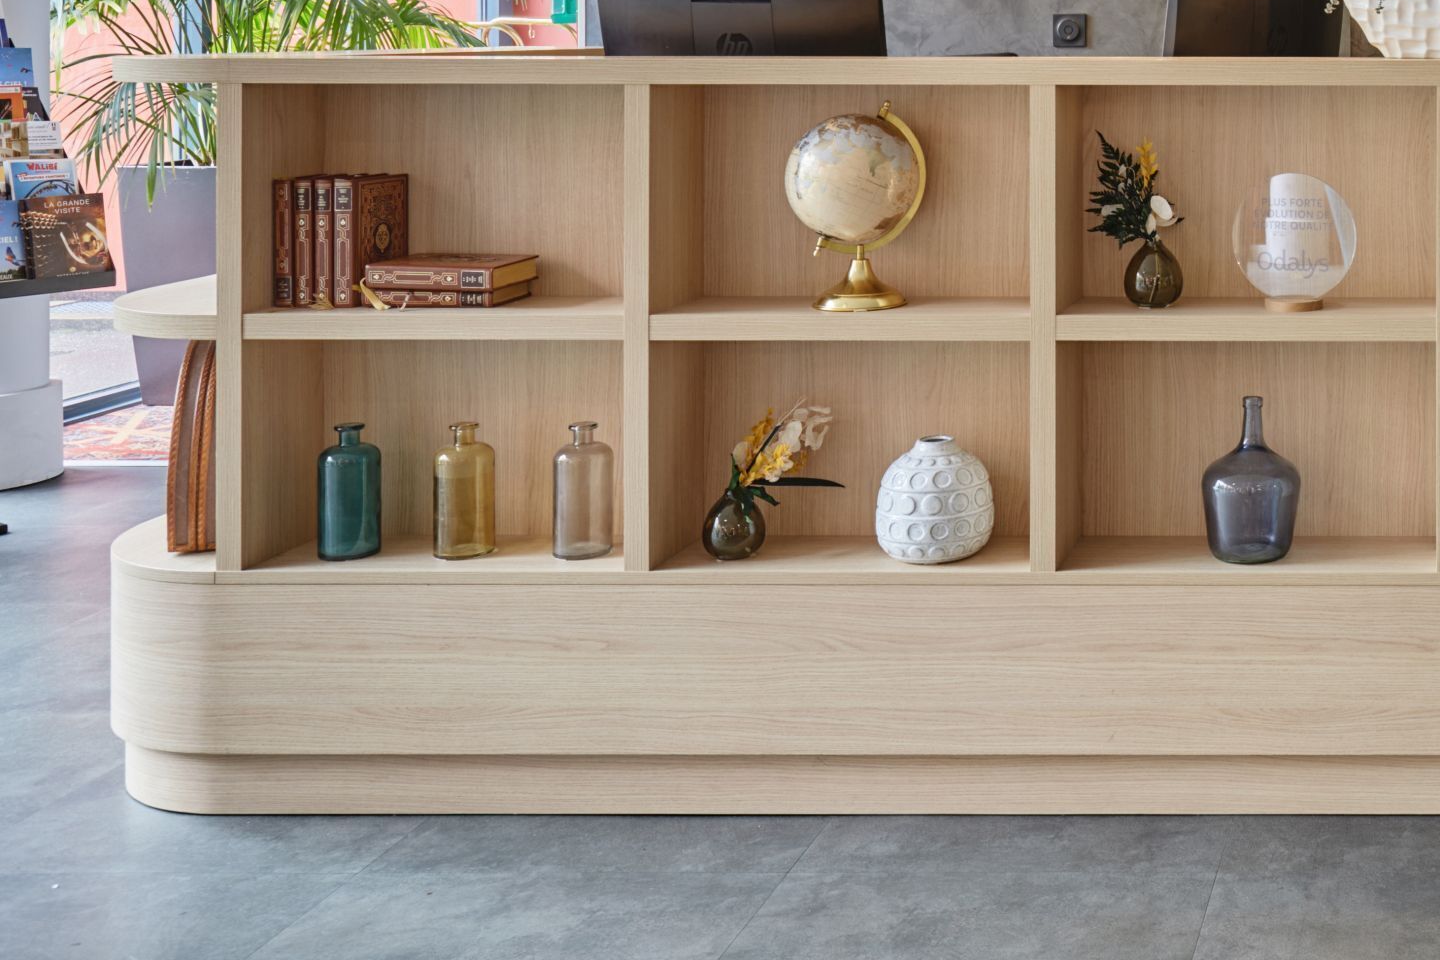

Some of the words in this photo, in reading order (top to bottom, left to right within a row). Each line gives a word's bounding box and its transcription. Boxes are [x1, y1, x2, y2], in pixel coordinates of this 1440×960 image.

[43, 201, 54, 209] LA
[56, 198, 90, 208] GRANDE
[1261, 198, 1287, 208] PLUS
[1290, 198, 1323, 208] FORTE
[54, 206, 80, 215] VISITE
[1256, 248, 1329, 279] Odalys
